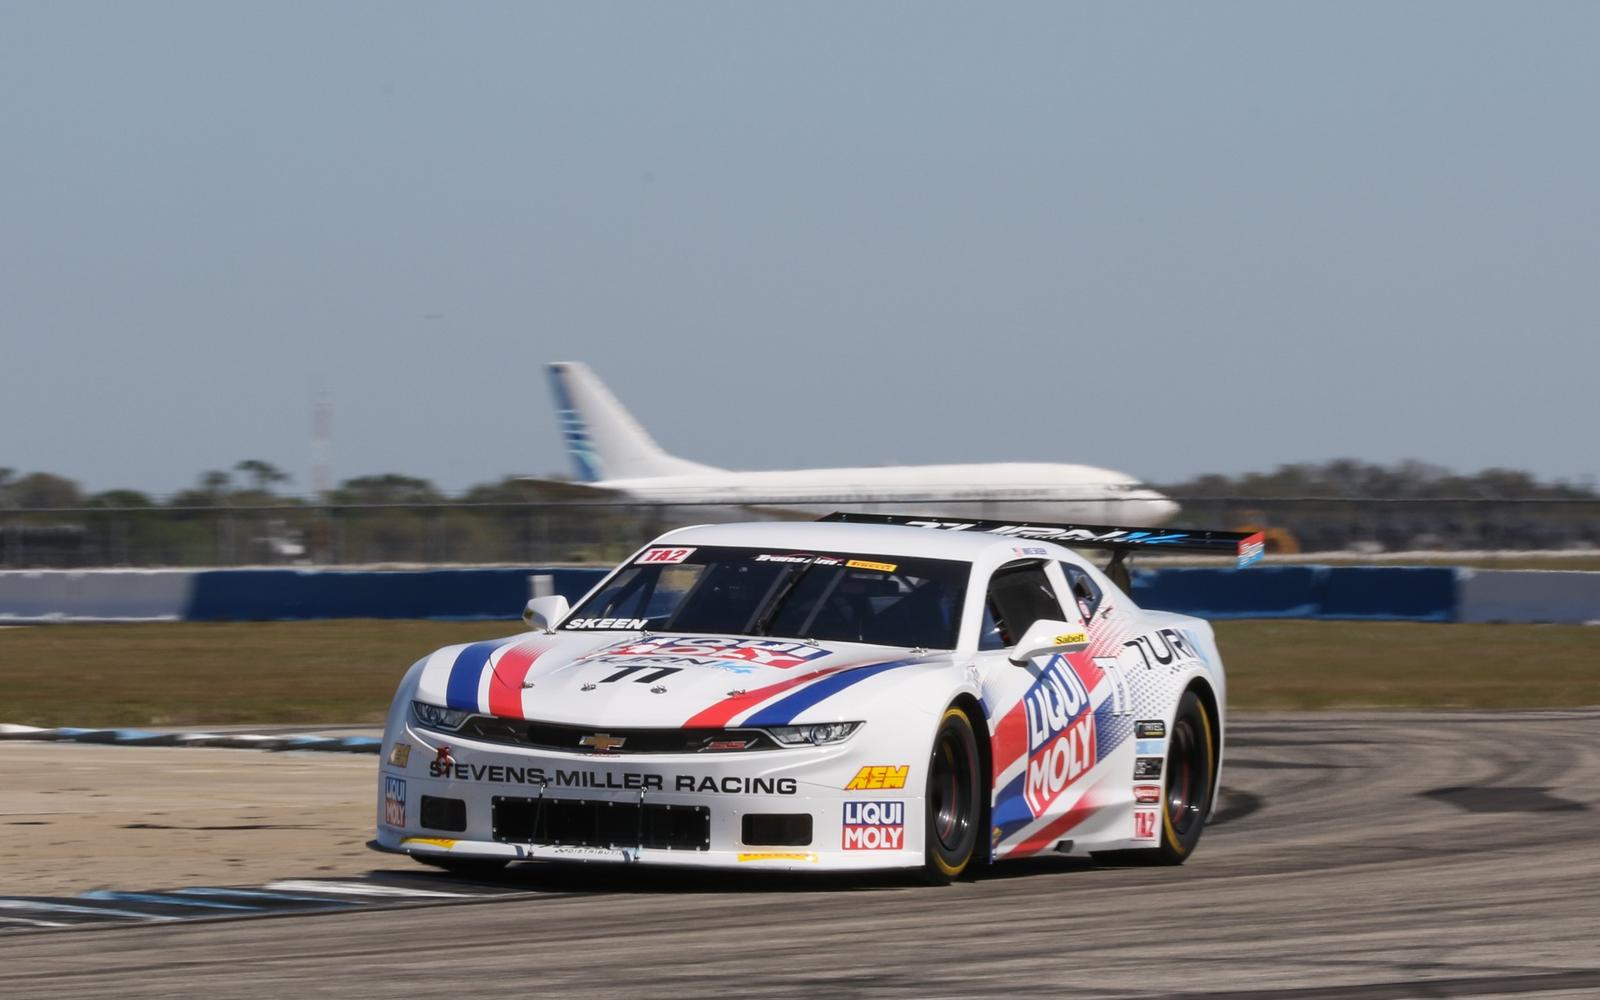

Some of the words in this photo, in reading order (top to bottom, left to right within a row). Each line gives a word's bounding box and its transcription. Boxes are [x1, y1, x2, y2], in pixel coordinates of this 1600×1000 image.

[644, 549, 689, 561] TA2
[565, 618, 649, 630] SKEEN
[1027, 656, 1088, 750] LIQUI
[1029, 714, 1092, 812] MOLY
[386, 778, 406, 802] LIQUI
[429, 760, 663, 791] STEVENS-MILLER
[675, 775, 798, 795] RACING
[844, 764, 911, 791] AEM
[386, 801, 405, 827] MOLY
[845, 802, 902, 825] LIQUI
[844, 826, 904, 849] MOLY
